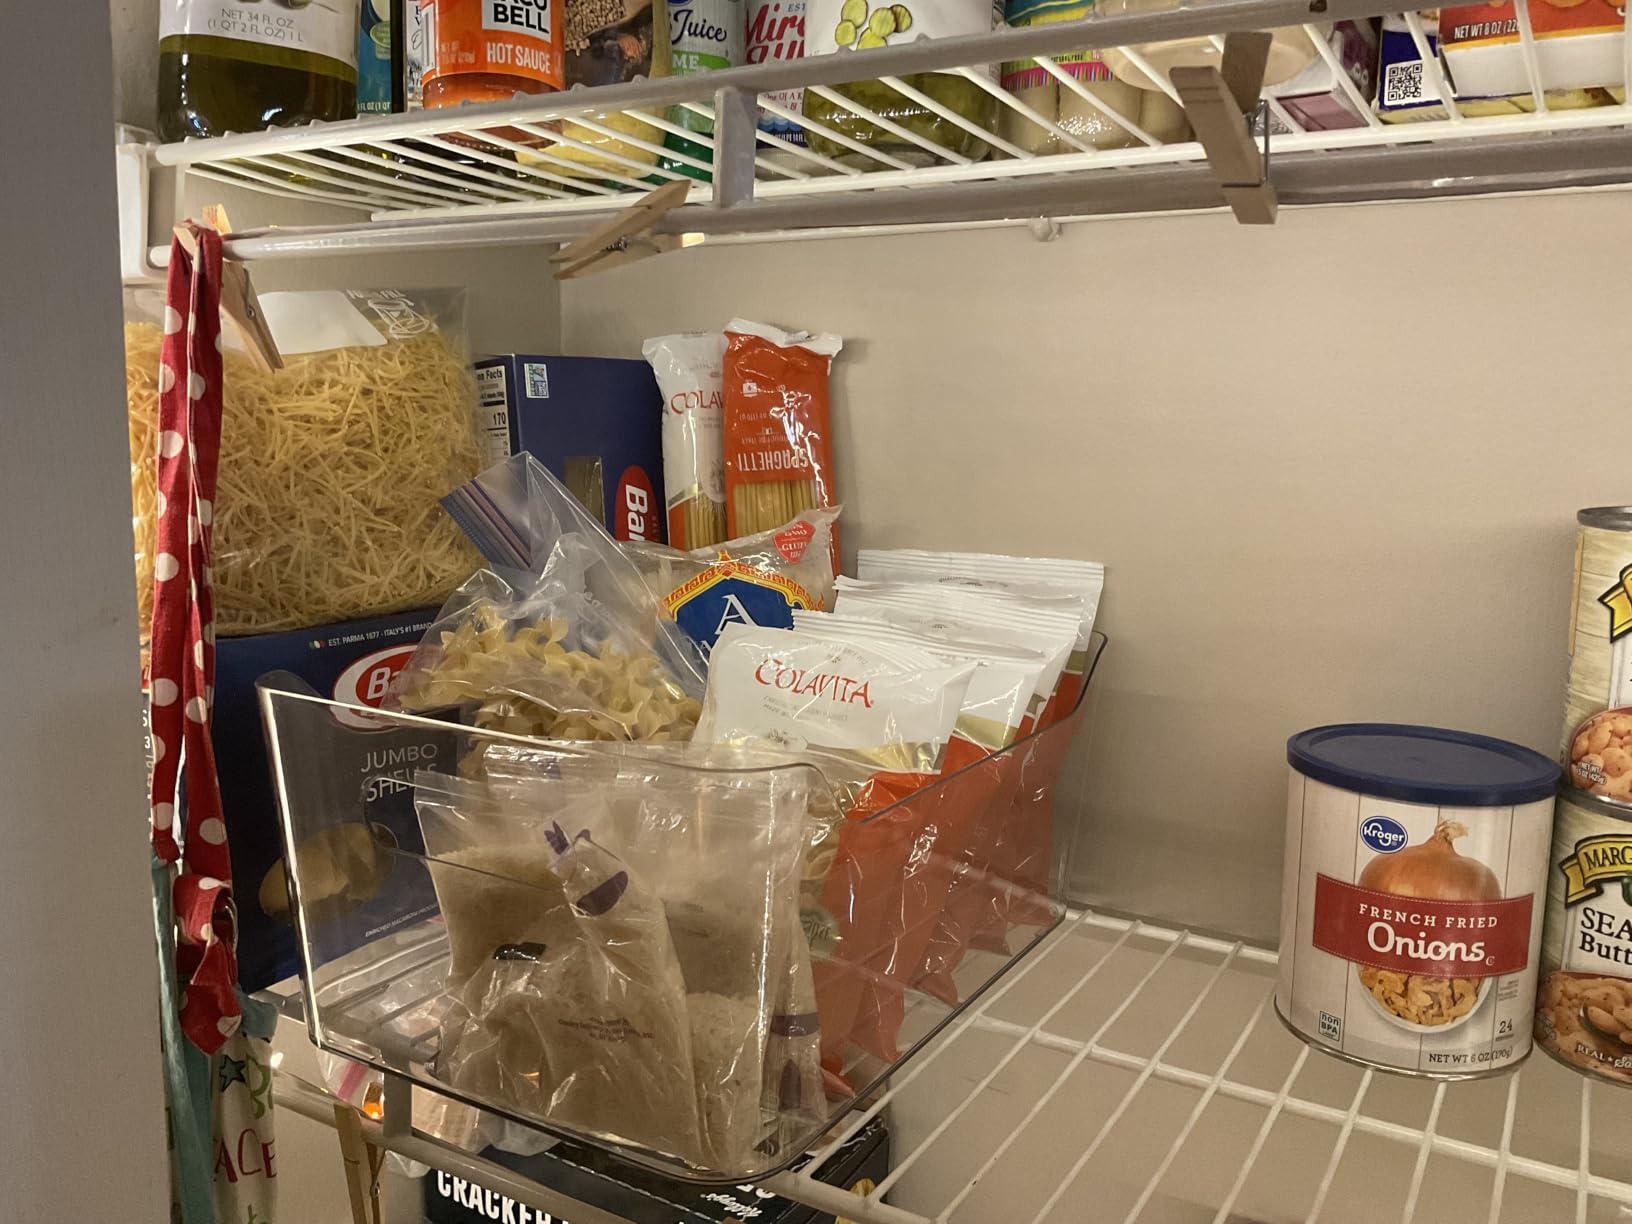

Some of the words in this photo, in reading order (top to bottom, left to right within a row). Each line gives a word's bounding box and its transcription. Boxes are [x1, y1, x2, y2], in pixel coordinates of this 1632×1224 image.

[220, 19, 237, 31] QT
[240, 23, 247, 33] 2
[250, 24, 261, 35] FL
[264, 26, 286, 40] OZ)
[298, 32, 304, 42] L
[221, 8, 243, 20] NET
[247, 12, 259, 22] 34
[262, 14, 274, 26] FL
[276, 17, 294, 29] OZ
[493, 3, 550, 34] BELL
[672, 9, 727, 46] Juice
[1454, 25, 1470, 39] NET
[1470, 23, 1483, 37] WT
[1491, 21, 1502, 35] OZ
[487, 41, 513, 65] HOT
[515, 45, 551, 75] SAUCE
[486, 368, 503, 380] Facts
[493, 412, 506, 426] 170
[737, 447, 809, 472] SPAGHETTI
[328, 638, 342, 647] EST.
[342, 634, 365, 644] PARMA
[384, 626, 405, 637] ITALY'S
[412, 622, 433, 632] BRAND
[755, 657, 872, 709] COLAVITA
[360, 743, 438, 773] JUMBO
[1363, 822, 1405, 847] Kroger
[1359, 903, 1437, 927] FRENCH
[1445, 915, 1498, 929] FRIED
[1367, 921, 1486, 962] Onions
[1321, 1014, 1339, 1026] non
[1321, 1021, 1338, 1035] BPA
[1499, 1018, 1513, 1034] 24
[1428, 1053, 1450, 1063] NET
[1452, 1054, 1468, 1063] WT
[1477, 1052, 1490, 1062] OZ
[1577, 1044, 1606, 1062] REAL
